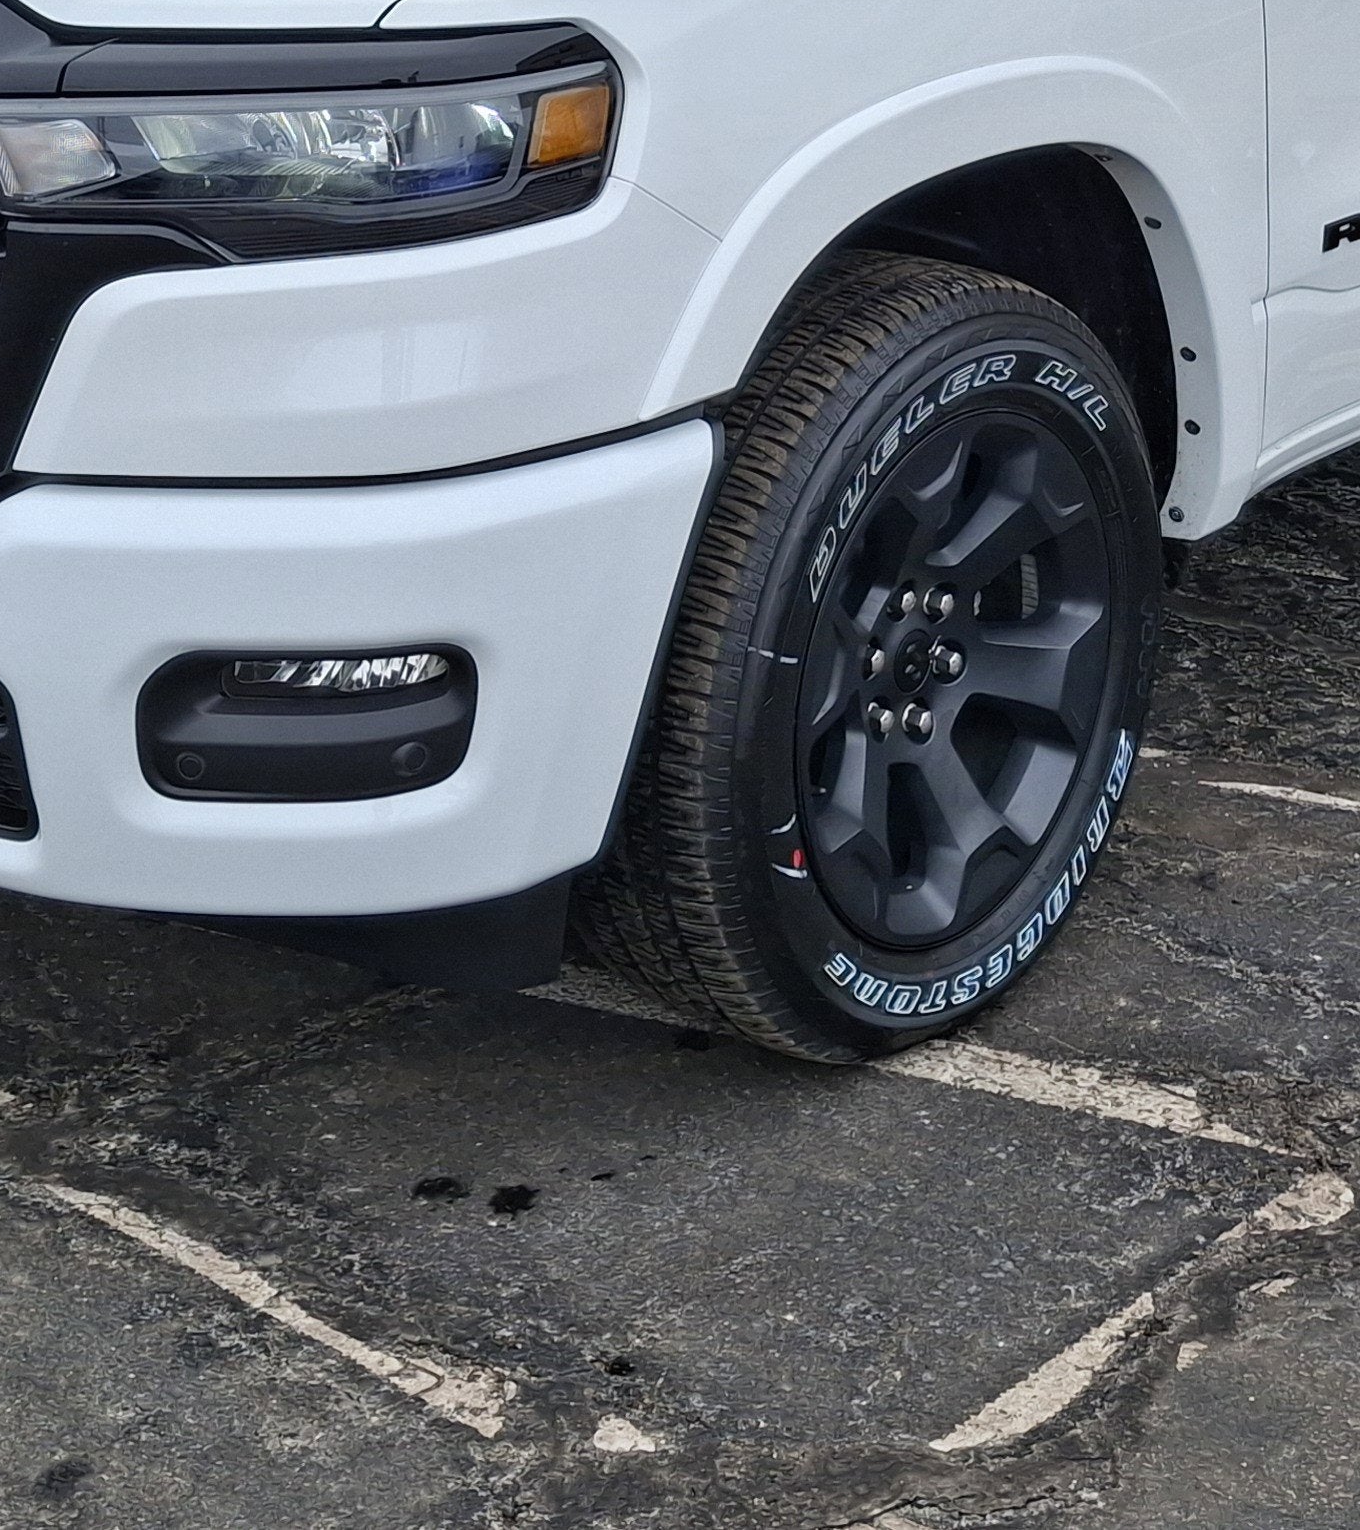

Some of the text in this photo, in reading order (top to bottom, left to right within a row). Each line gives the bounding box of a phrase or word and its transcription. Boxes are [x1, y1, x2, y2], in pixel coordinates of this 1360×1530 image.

[809, 354, 1111, 604] DUELER H/L
[823, 727, 1134, 1015] BRIDGESTONE
